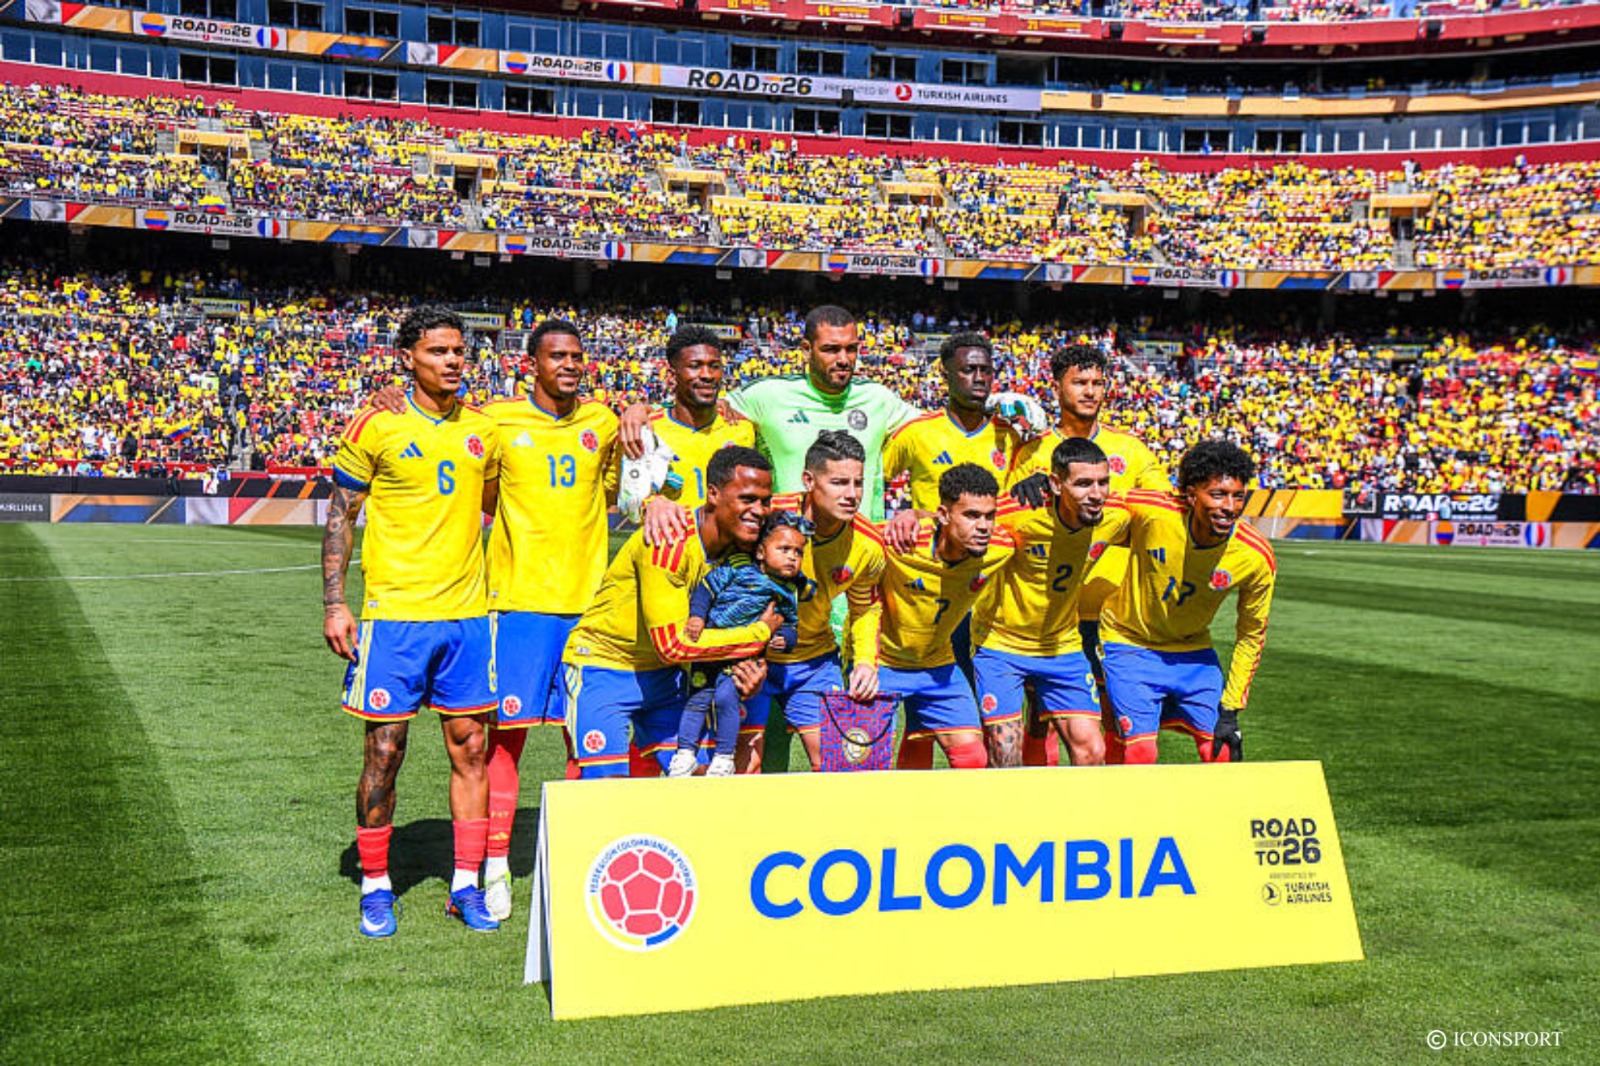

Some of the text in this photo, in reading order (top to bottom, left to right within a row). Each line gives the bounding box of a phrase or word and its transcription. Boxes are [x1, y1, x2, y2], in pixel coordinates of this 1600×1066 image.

[171, 18, 218, 34] ROAD
[231, 25, 251, 37] 26
[532, 56, 572, 69] ROAD
[584, 61, 603, 72] 26
[687, 69, 760, 92] ROAD
[762, 82, 780, 93] TO
[781, 77, 813, 95] 26
[917, 89, 962, 101] TURKISH
[963, 93, 1009, 104] AIRLINES
[173, 212, 220, 225] ROAD
[233, 217, 252, 229] 26
[532, 237, 572, 250] ROAD
[852, 256, 889, 267] ROAD
[437, 460, 456, 495] 6
[547, 454, 577, 488] 13
[1458, 523, 1493, 536] ROAD
[1052, 564, 1073, 592] 2
[1161, 575, 1196, 606] 17
[935, 599, 950, 625] 7
[1250, 818, 1317, 838] ROAD
[1254, 837, 1322, 866] TO 26
[749, 835, 1197, 920] COLOMBIA
[1284, 881, 1331, 893] TURKISH
[1286, 892, 1333, 904] AIRLINES
